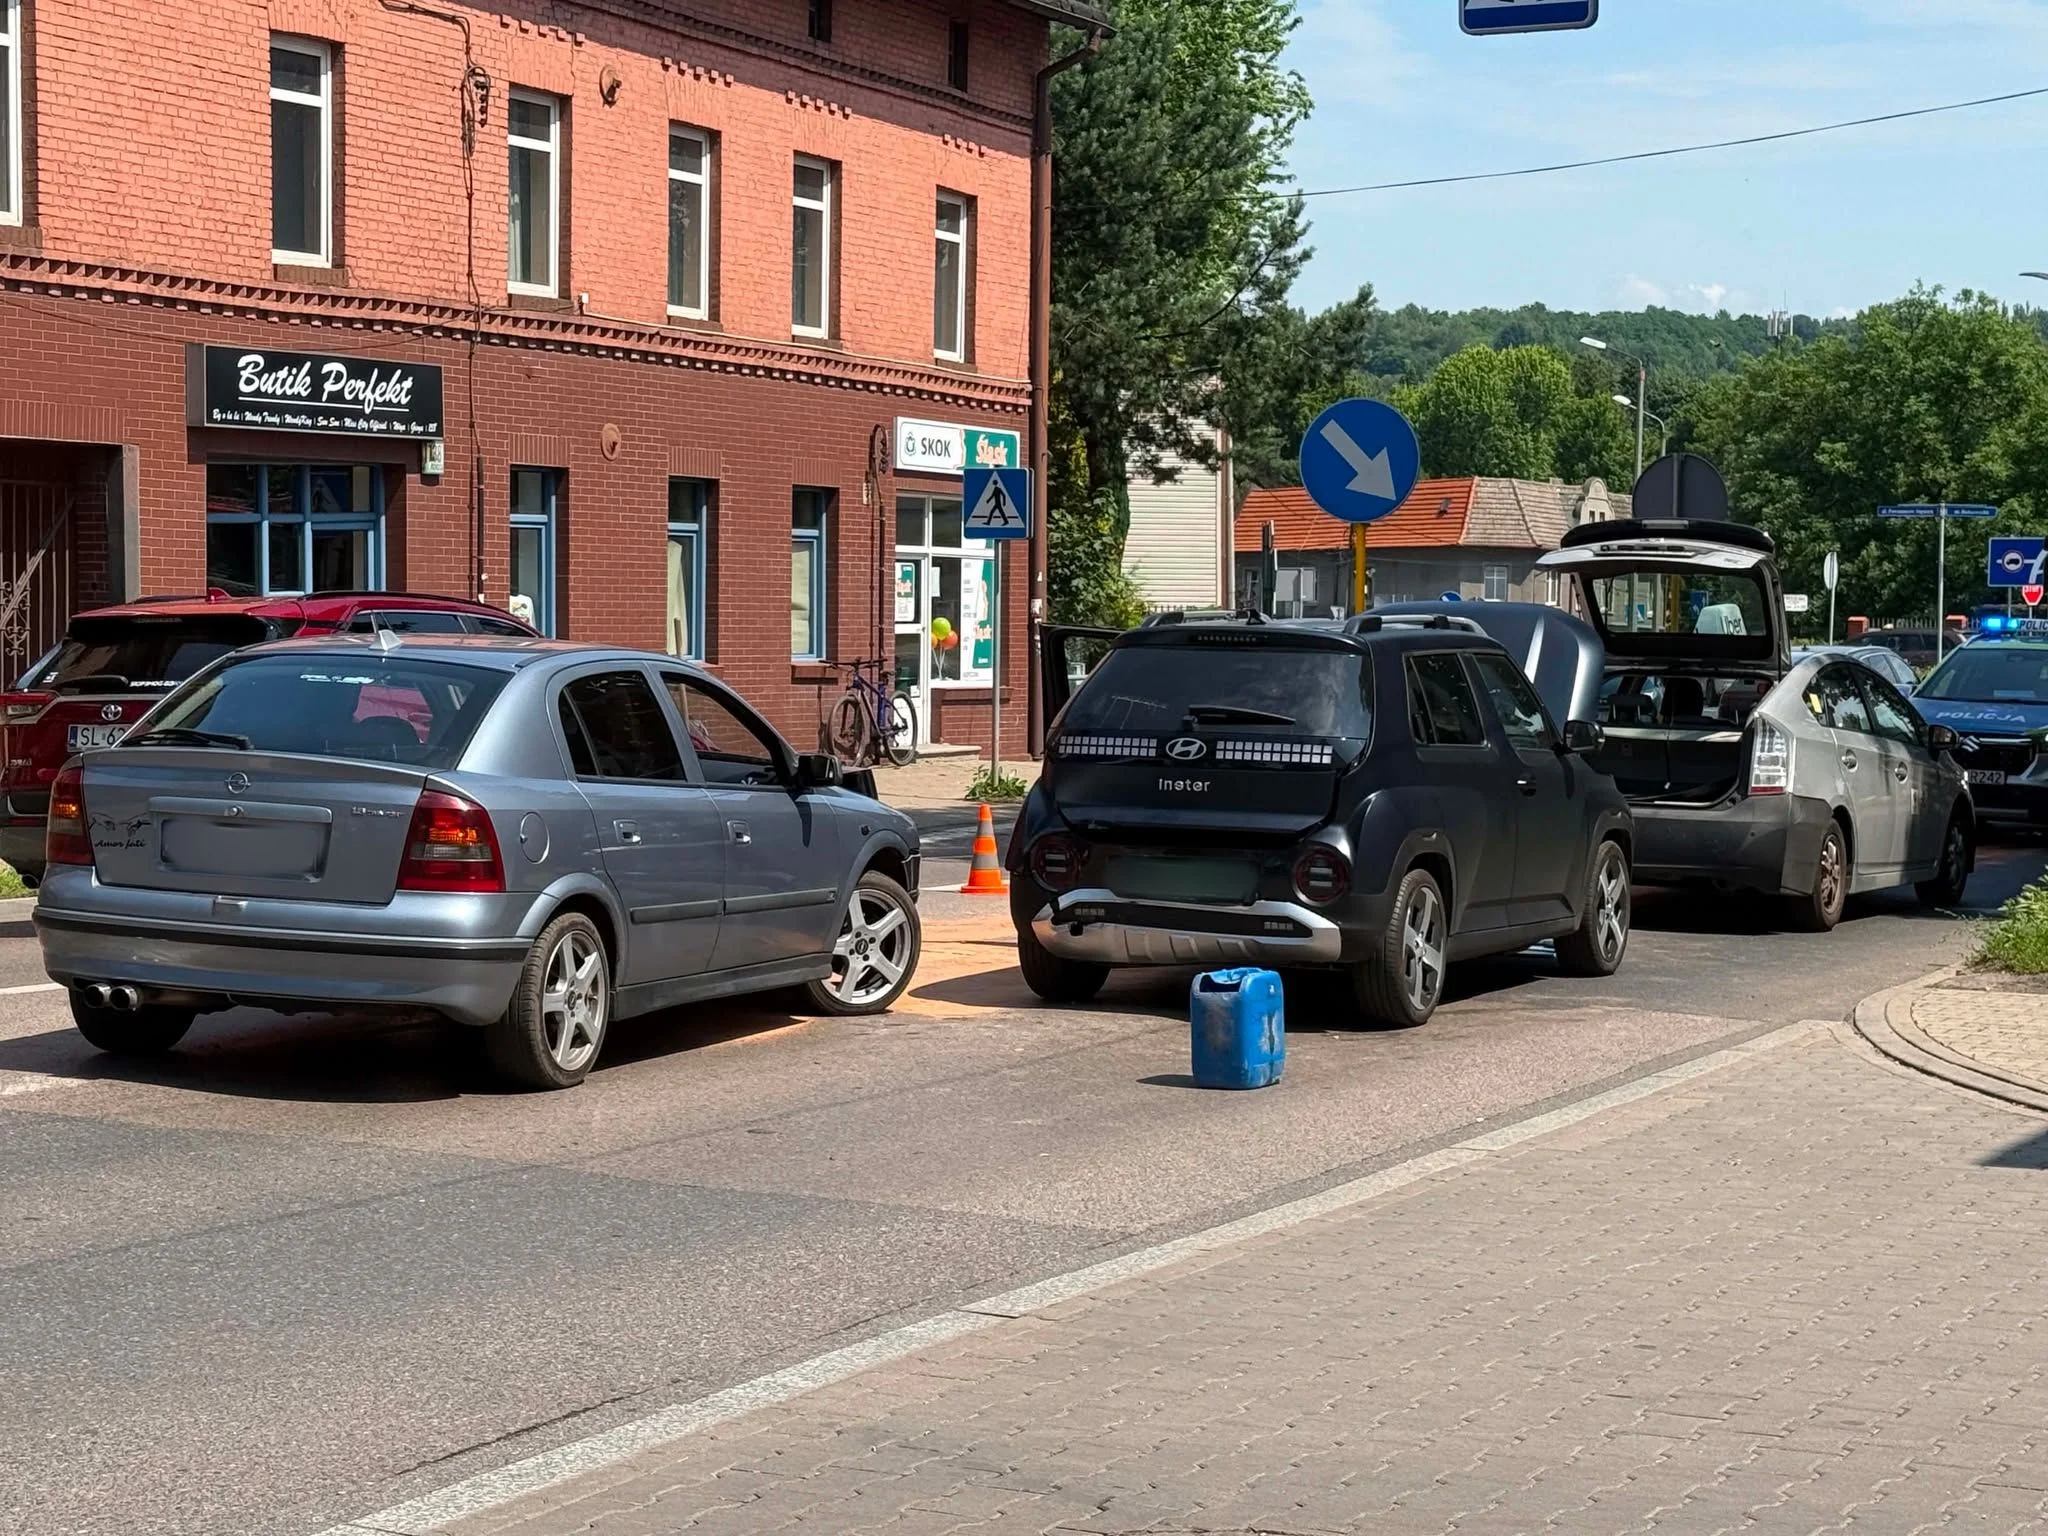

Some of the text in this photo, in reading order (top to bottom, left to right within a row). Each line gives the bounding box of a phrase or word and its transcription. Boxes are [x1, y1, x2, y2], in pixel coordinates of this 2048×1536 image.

[237, 354, 414, 414] Butik Perfekt
[921, 437, 951, 458] SKOK
[1936, 711, 2026, 723] POLICJA
[80, 727, 99, 746] SL
